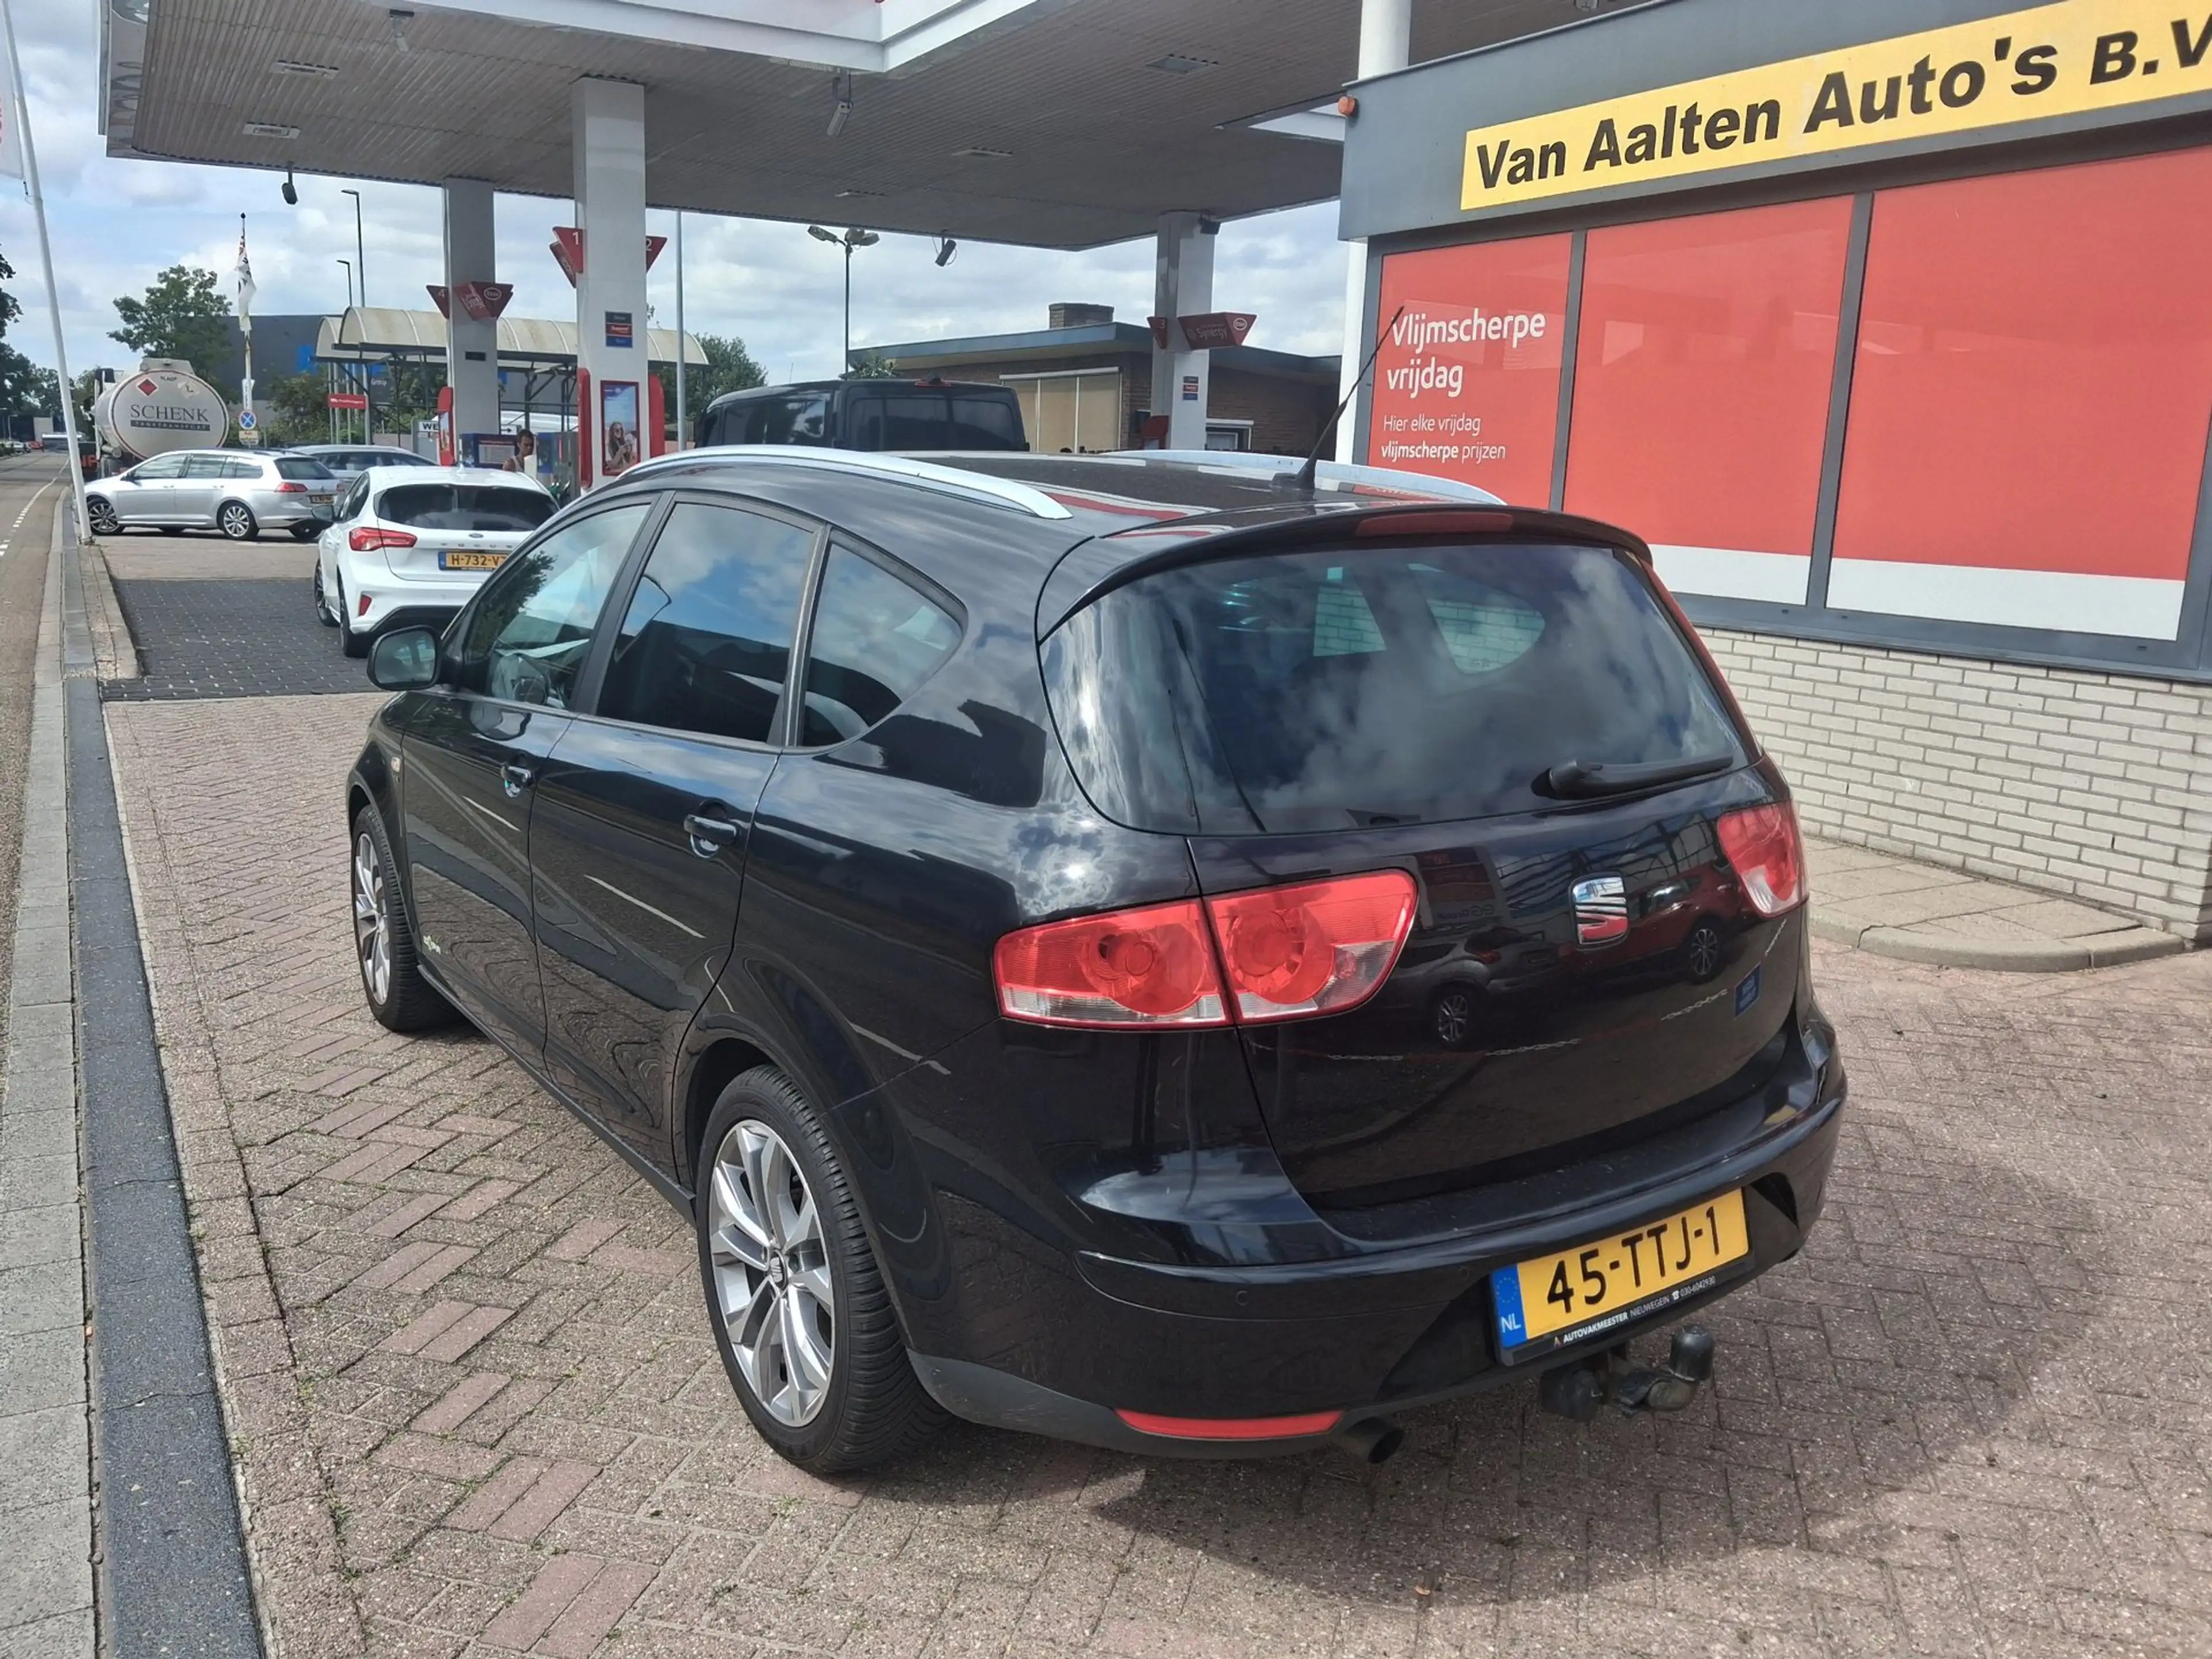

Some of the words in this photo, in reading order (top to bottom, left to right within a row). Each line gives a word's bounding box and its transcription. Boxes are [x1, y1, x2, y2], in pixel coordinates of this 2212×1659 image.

[1476, 139, 1566, 189] Van
[1583, 101, 1781, 171] Aalten
[1802, 36, 2058, 134] Auto's
[572, 232, 579, 245] 1
[646, 238, 652, 251] 2
[438, 289, 445, 298] 4
[1392, 308, 1546, 354] Vlijmscherpe
[1387, 357, 1464, 399] vrijdag
[130, 404, 209, 422] SCHENK
[1383, 415, 1408, 432] Hier
[1411, 414, 1435, 431] elke
[1438, 412, 1482, 437] vrijdag
[1381, 441, 1459, 464] vlijmscherpe
[1461, 441, 1506, 464] prijzen
[1547, 1206, 1720, 1314] 45-TTJ-1
[1501, 1313, 1521, 1333] NL
[1563, 1312, 1629, 1343] AUTOVAKMEESTER
[1630, 1295, 1670, 1317] NIEUWEGEIN
